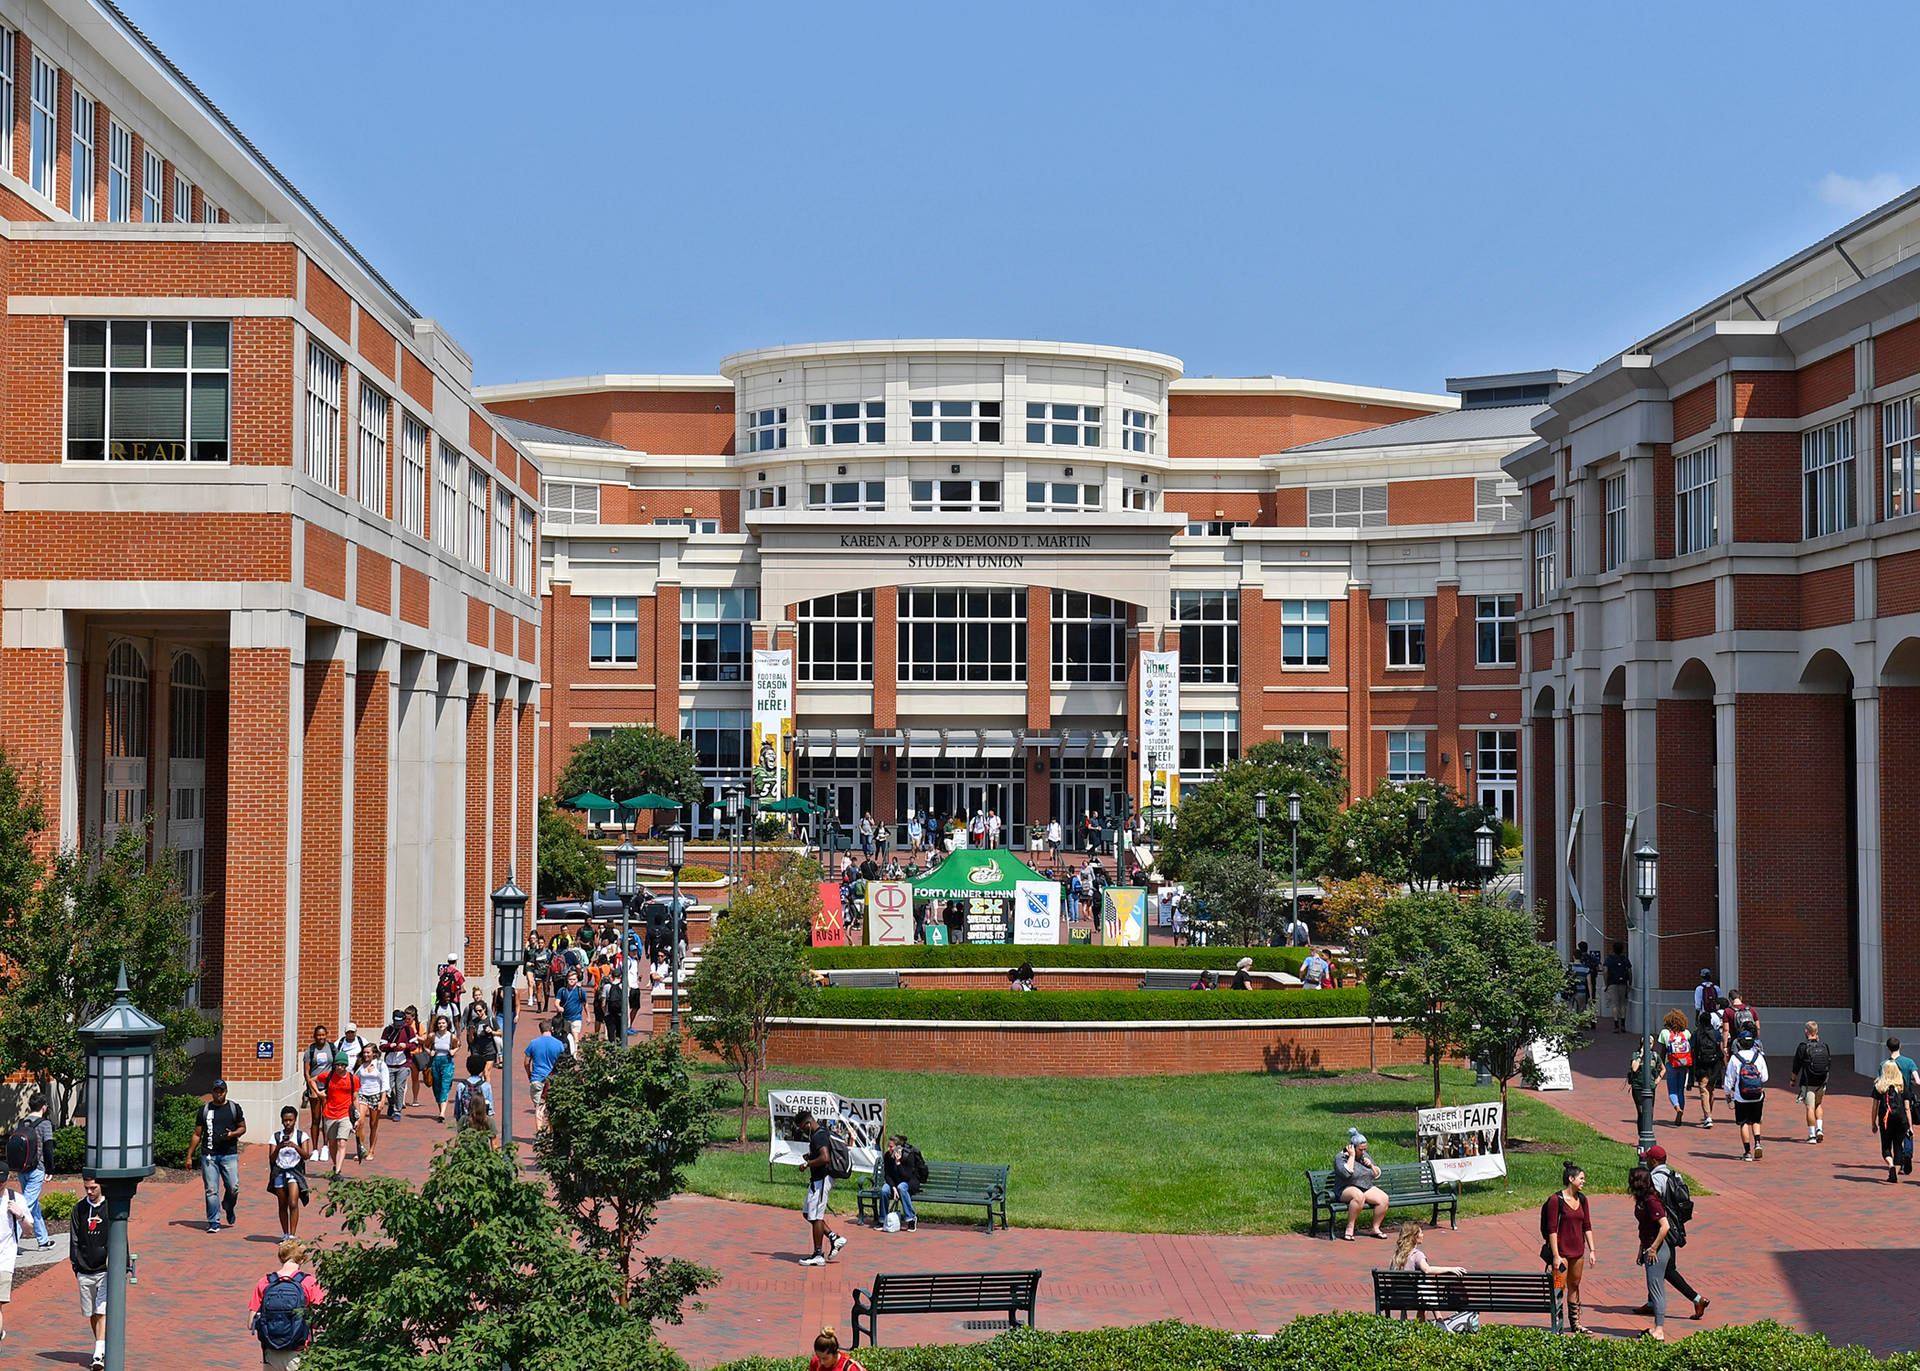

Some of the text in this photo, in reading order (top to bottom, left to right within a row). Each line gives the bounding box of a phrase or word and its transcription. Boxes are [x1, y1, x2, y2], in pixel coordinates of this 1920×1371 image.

[110, 442, 186, 461] READ
[840, 535, 1091, 547] KAREN A. POPP & DEMOND T. MARTIN
[908, 555, 1024, 568] STUDENT UNION
[757, 681, 787, 689] SEASON
[769, 690, 776, 698] IS
[757, 699, 787, 711] HERE!
[1148, 751, 1171, 761] EE!
[913, 888, 1016, 898] FORTY NINER RUNN
[816, 929, 840, 941] RUSH
[1071, 928, 1090, 939] RUSH
[785, 1095, 827, 1105] CAREER
[775, 1104, 836, 1116] INTERNSHIP
[839, 1099, 883, 1121] FAIR
[1426, 1111, 1457, 1122] CAREER
[1464, 1107, 1498, 1127] FAIR
